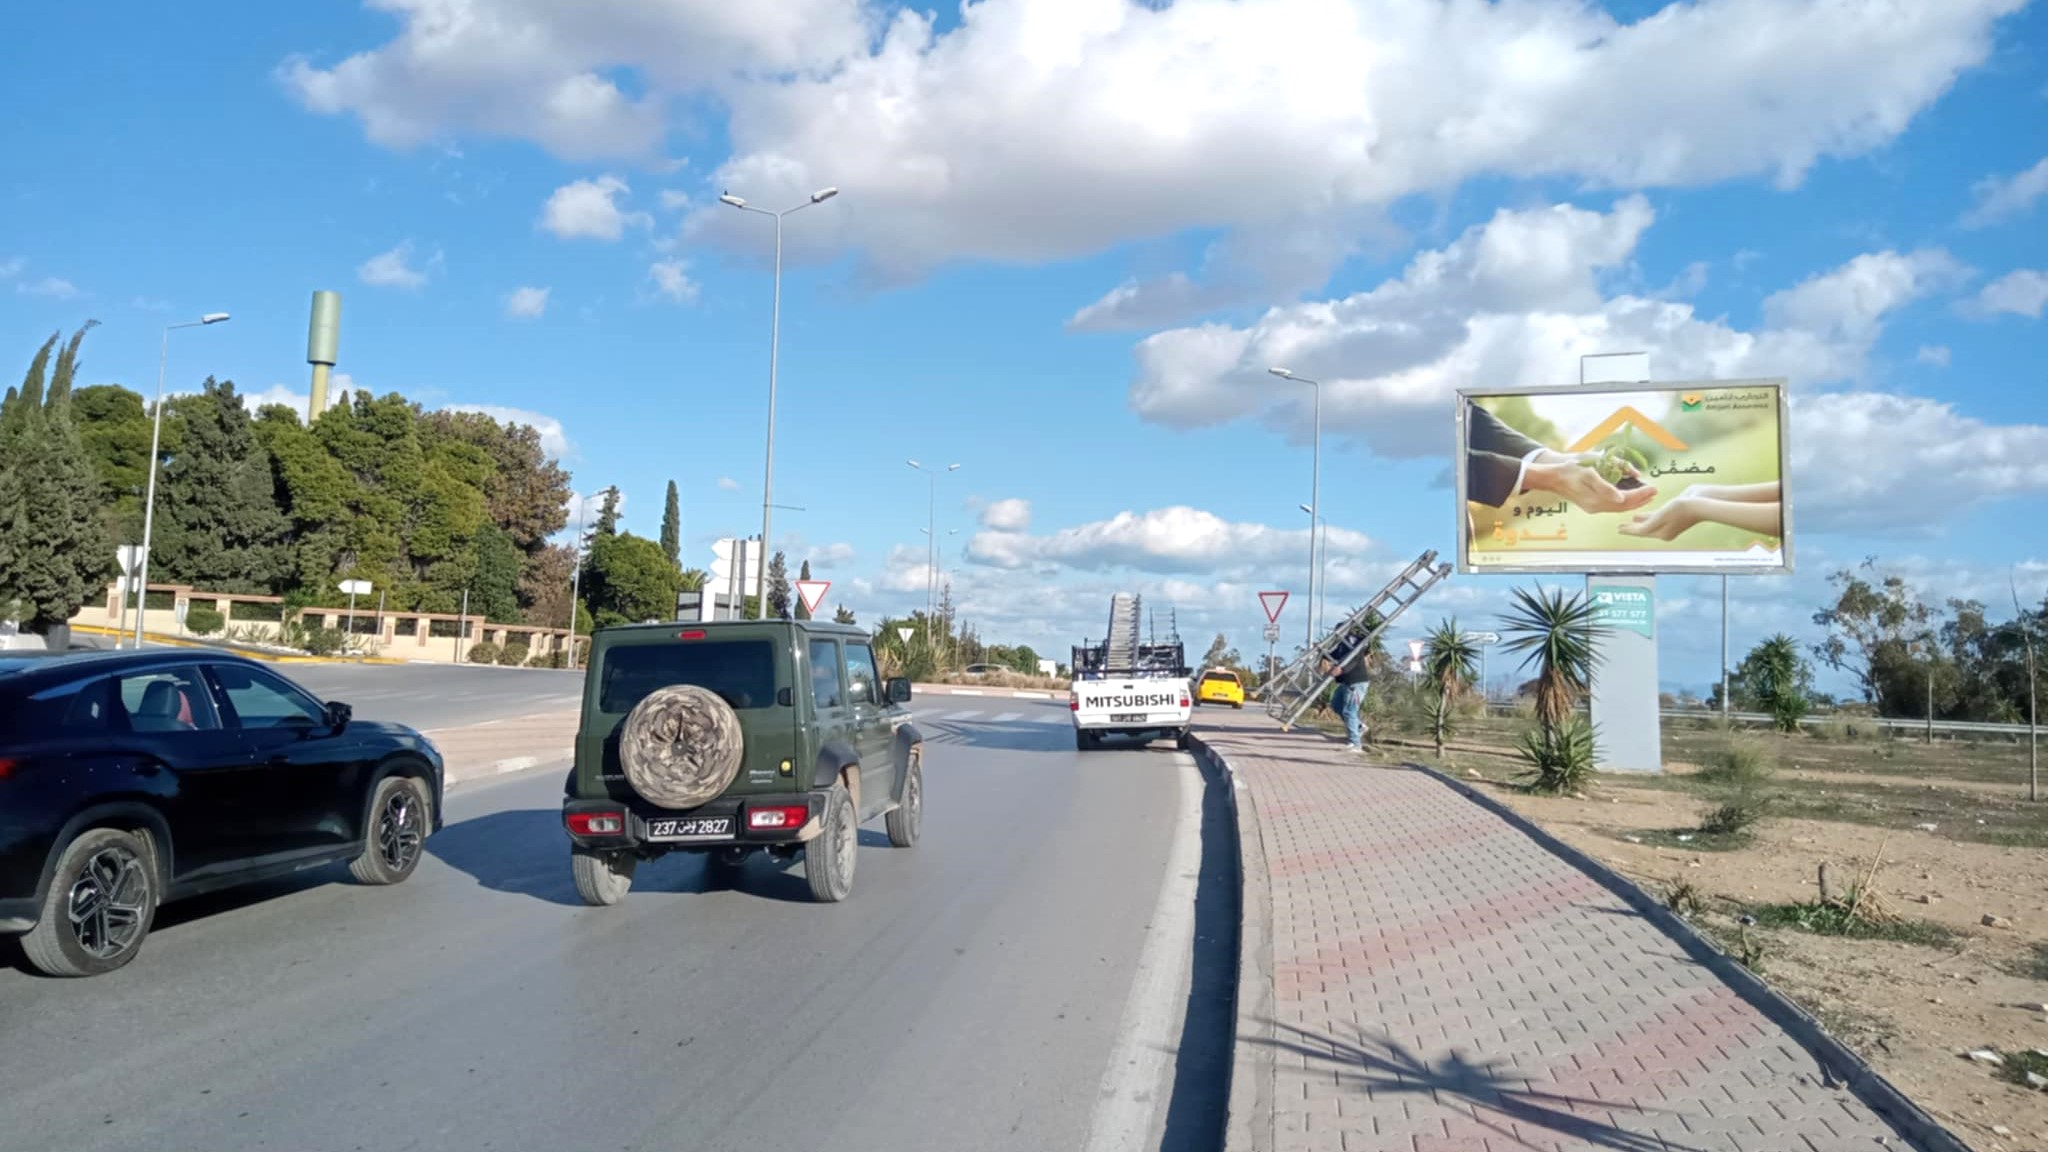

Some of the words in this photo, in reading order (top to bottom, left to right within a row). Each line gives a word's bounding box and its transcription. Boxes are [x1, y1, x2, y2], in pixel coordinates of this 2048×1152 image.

[1513, 506, 1521, 517] و
[1526, 502, 1567, 519] اليوم
[1614, 593, 1647, 602] VISTA
[1086, 694, 1174, 708] MITSUBISHI
[654, 821, 677, 836] 237
[698, 819, 729, 834] 2827
